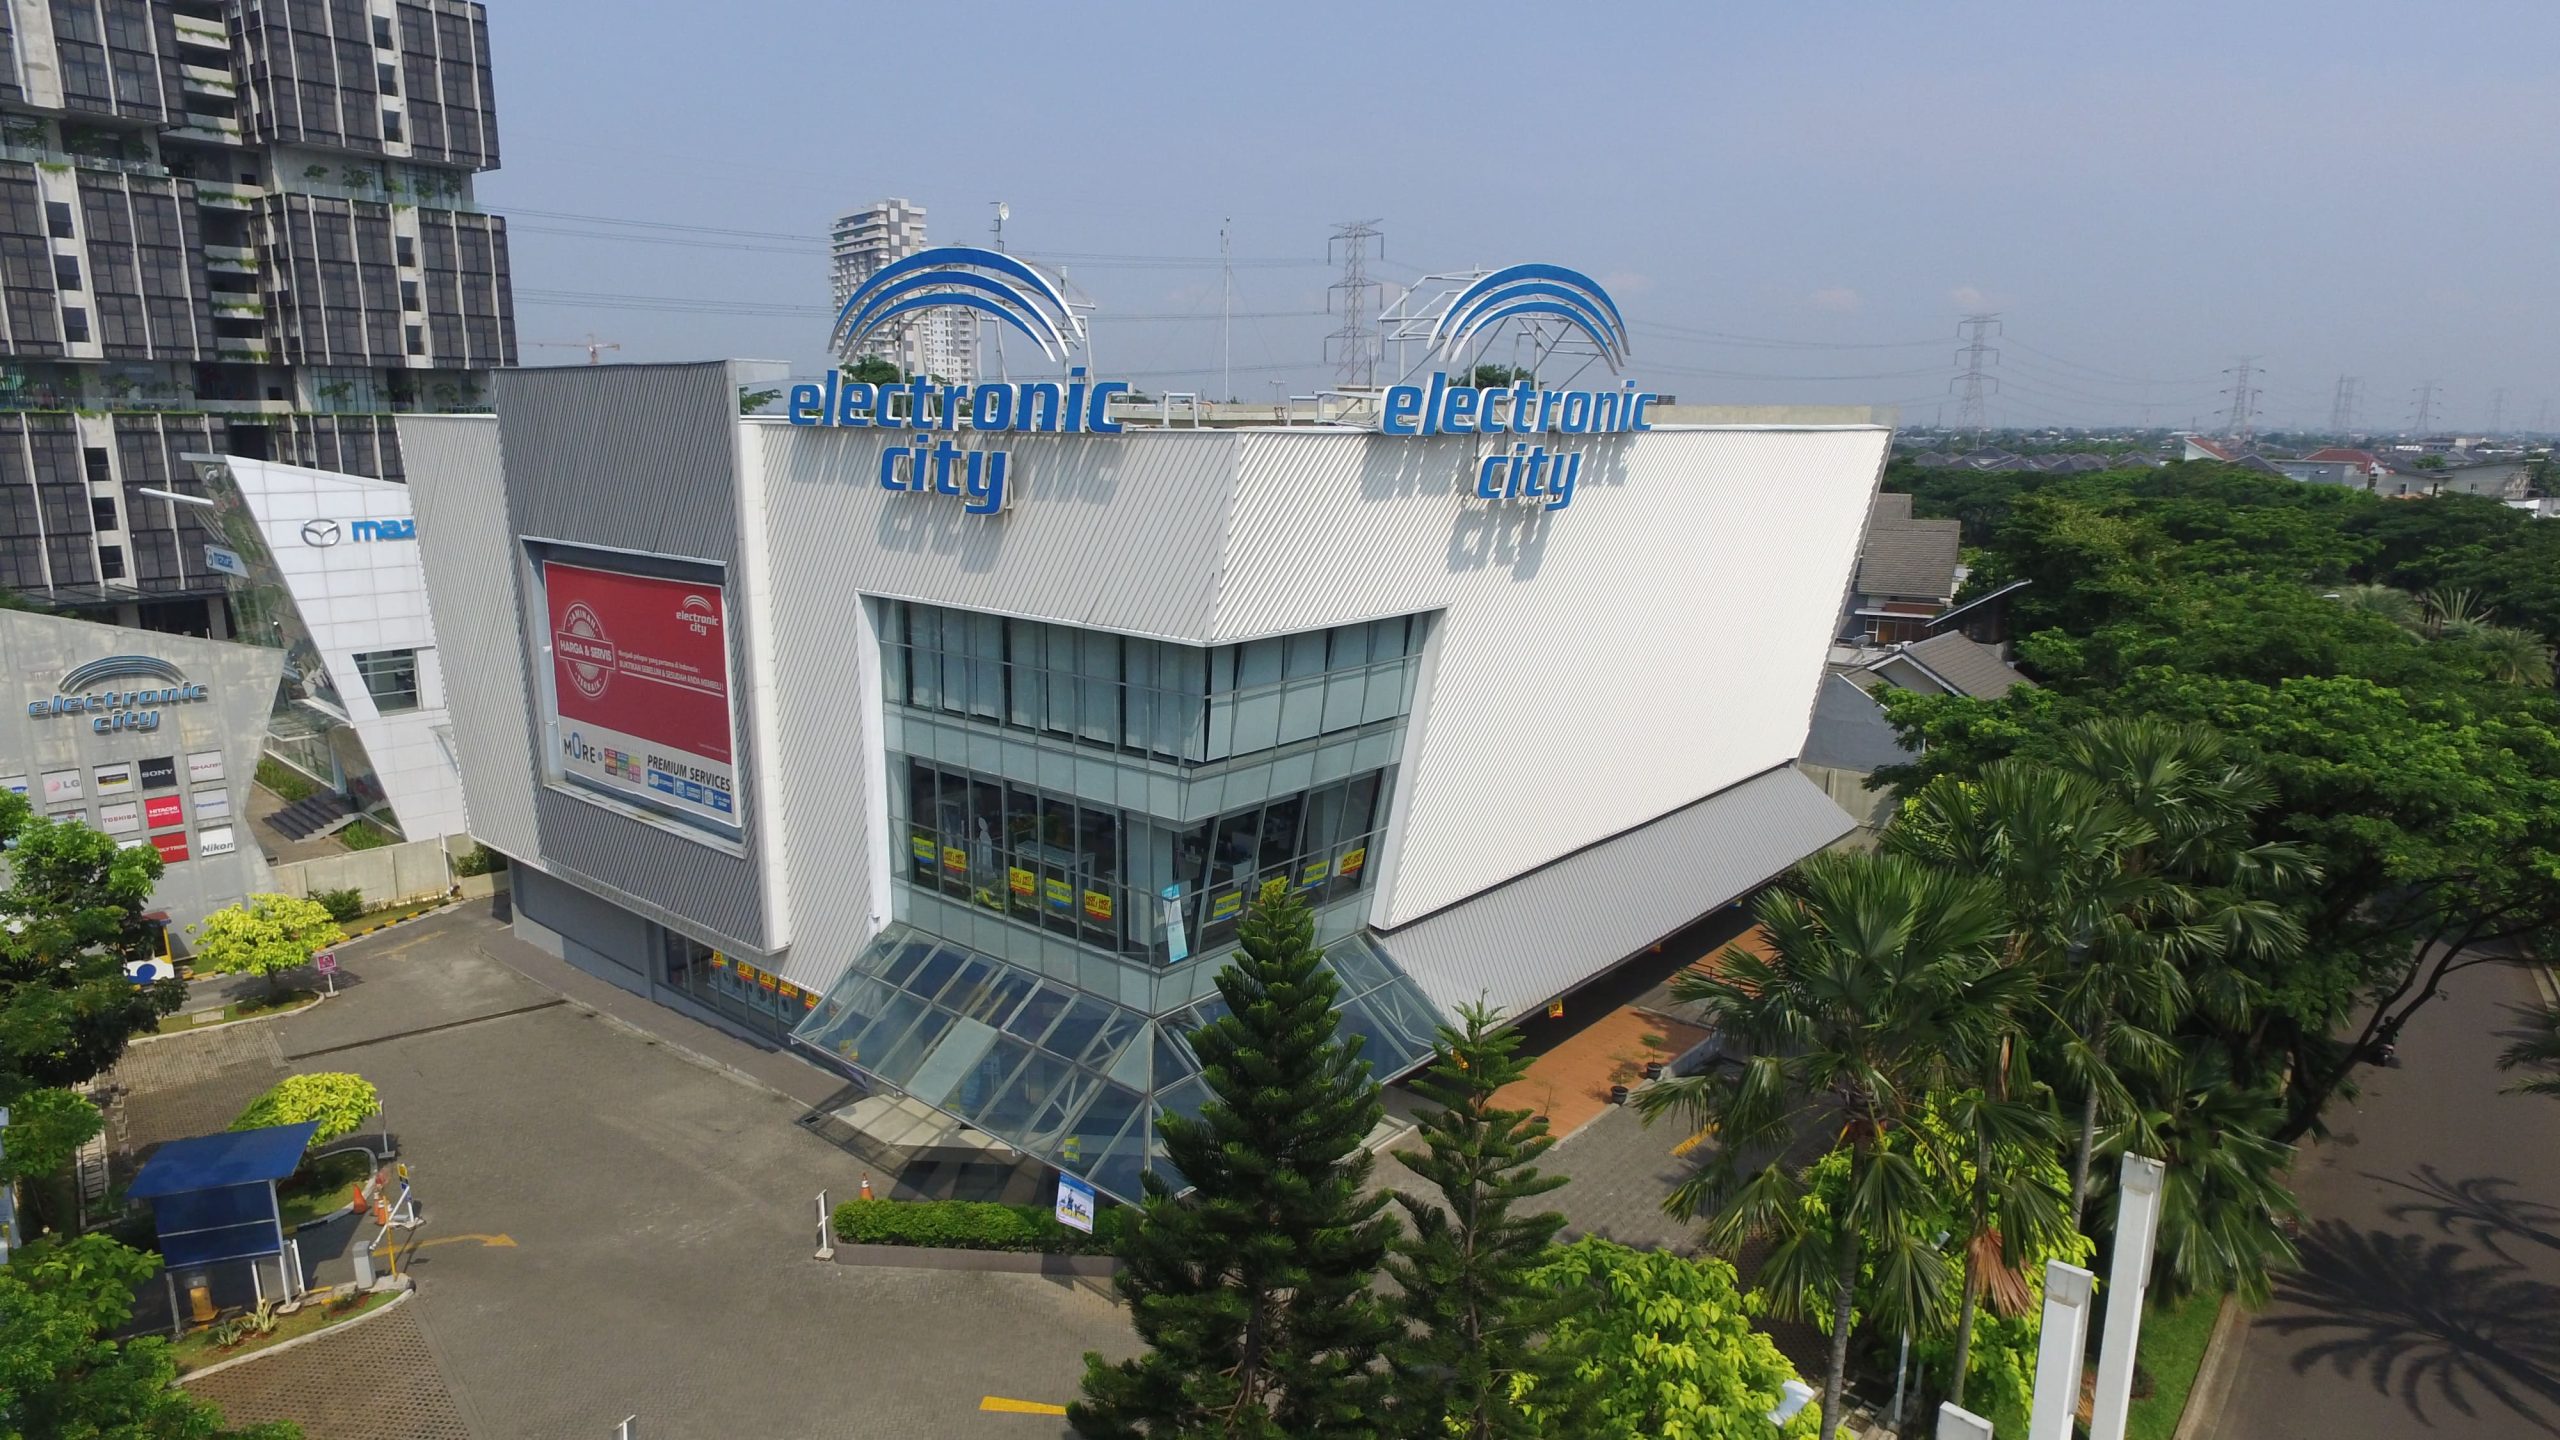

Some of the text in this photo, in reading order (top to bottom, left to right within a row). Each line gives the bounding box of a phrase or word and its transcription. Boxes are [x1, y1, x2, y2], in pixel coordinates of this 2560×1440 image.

[789, 366, 1133, 434] electronic
[1379, 371, 1657, 436] electronic
[881, 433, 1011, 515] city
[1474, 441, 1581, 511] city
[351, 519, 416, 542] maz
[676, 611, 719, 626] electronic
[690, 622, 707, 636] city
[560, 640, 584, 656] HARGA
[584, 645, 590, 657] &
[27, 681, 209, 718] electronic
[93, 708, 161, 733] city
[563, 732, 596, 764] MORE
[63, 779, 80, 789] LG
[141, 768, 174, 779] SONY
[647, 754, 687, 778] PREMIUM
[689, 767, 731, 792] SERVICES
[103, 814, 137, 823] TOSHIBA
[149, 805, 178, 815] HITACHI
[201, 842, 234, 854] Nikon
